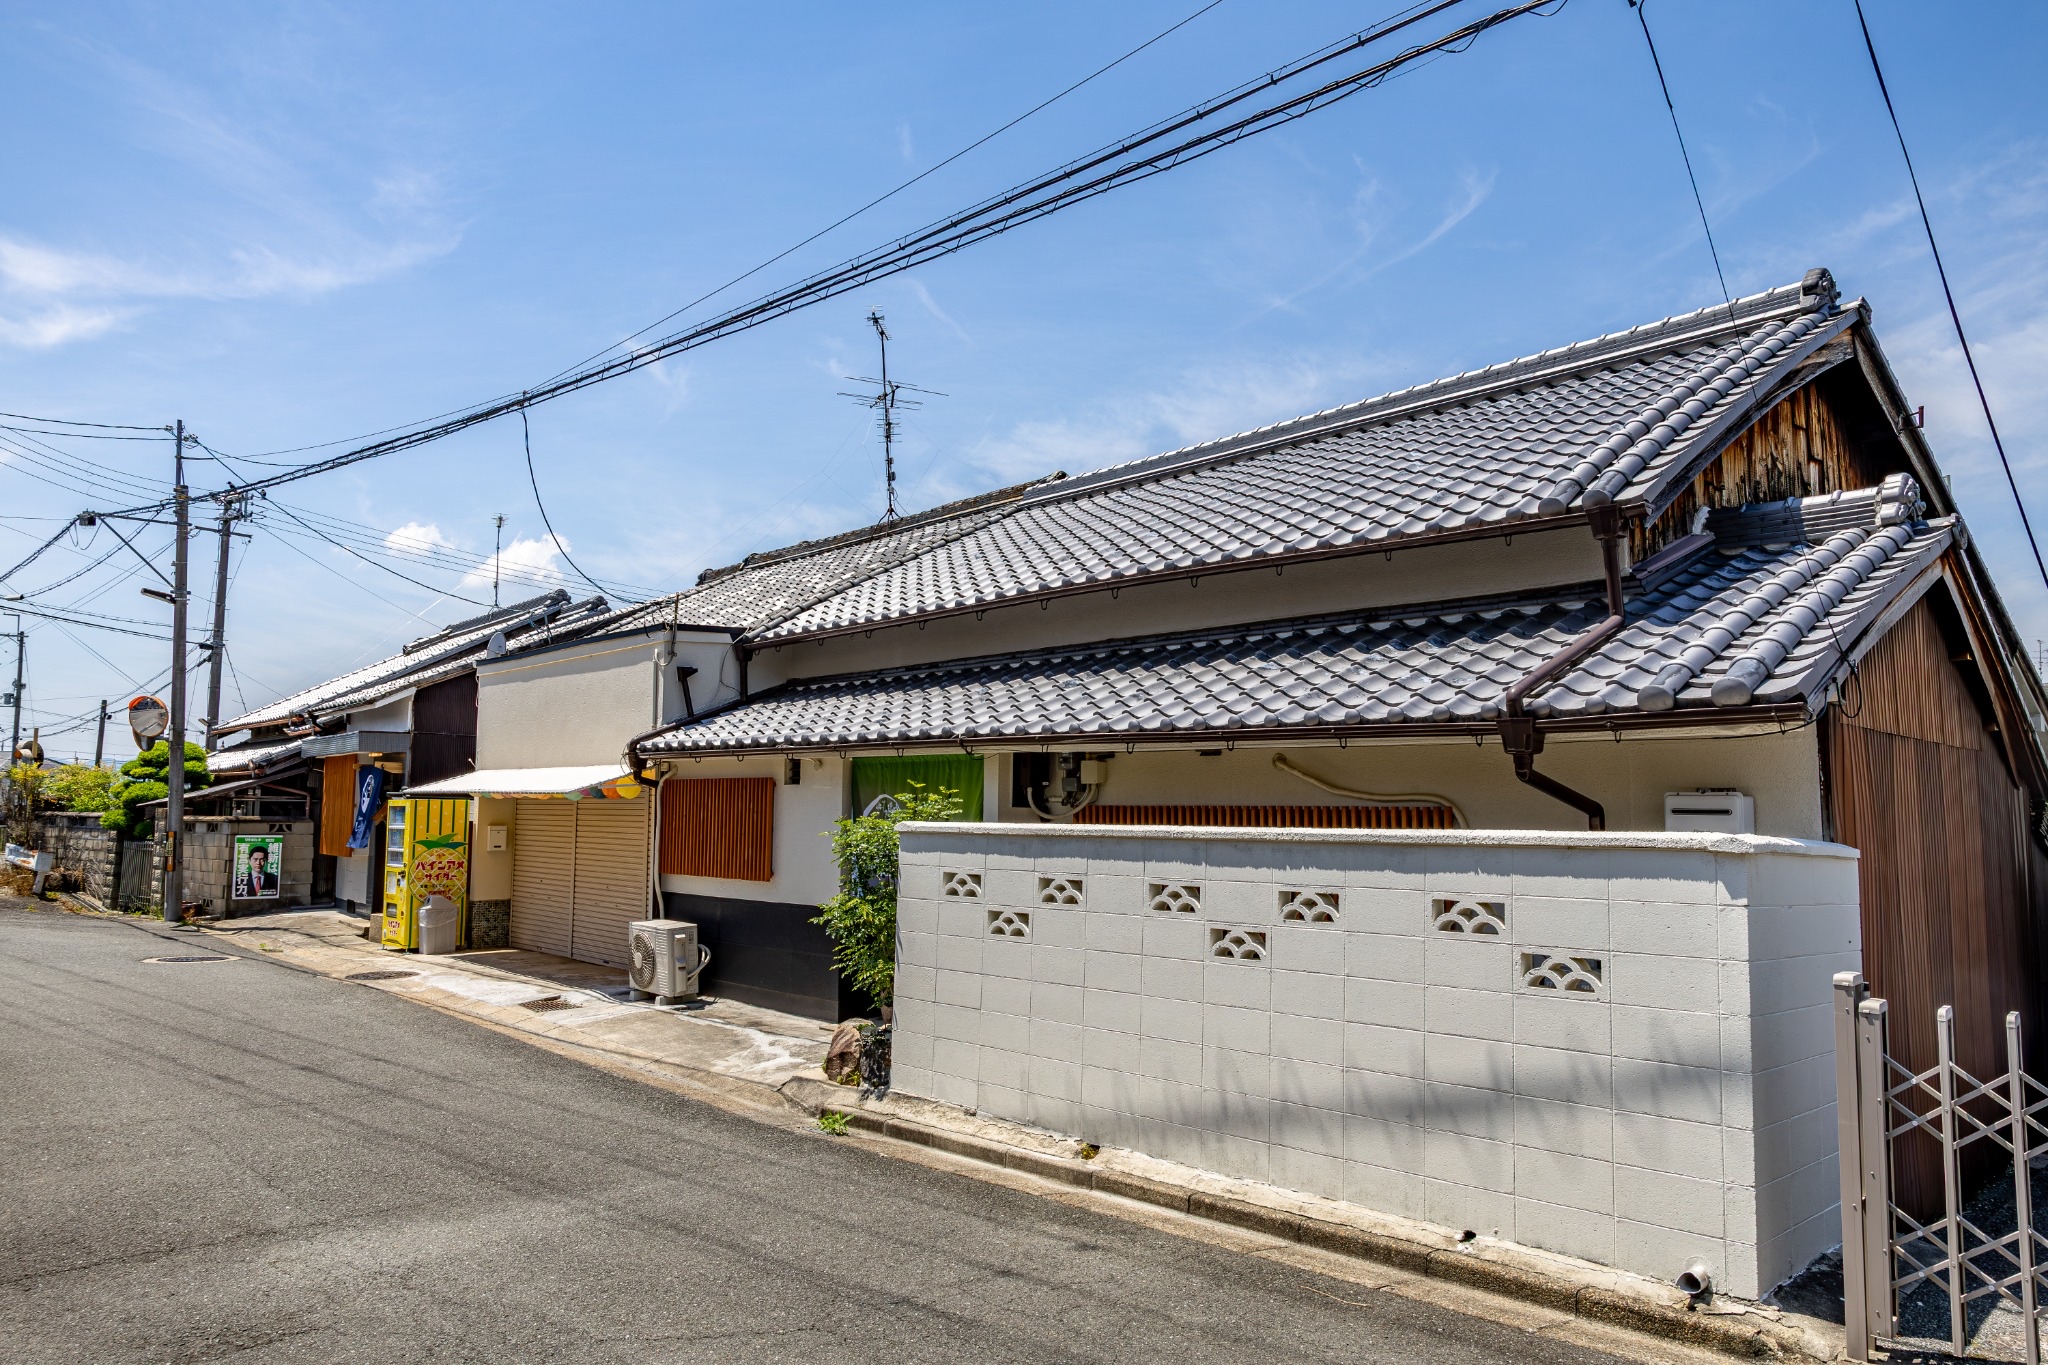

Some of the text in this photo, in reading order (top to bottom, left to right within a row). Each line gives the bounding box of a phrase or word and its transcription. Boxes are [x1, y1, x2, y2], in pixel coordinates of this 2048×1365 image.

[416, 860, 465, 871] パインアメ
[424, 872, 457, 881] サイダー
